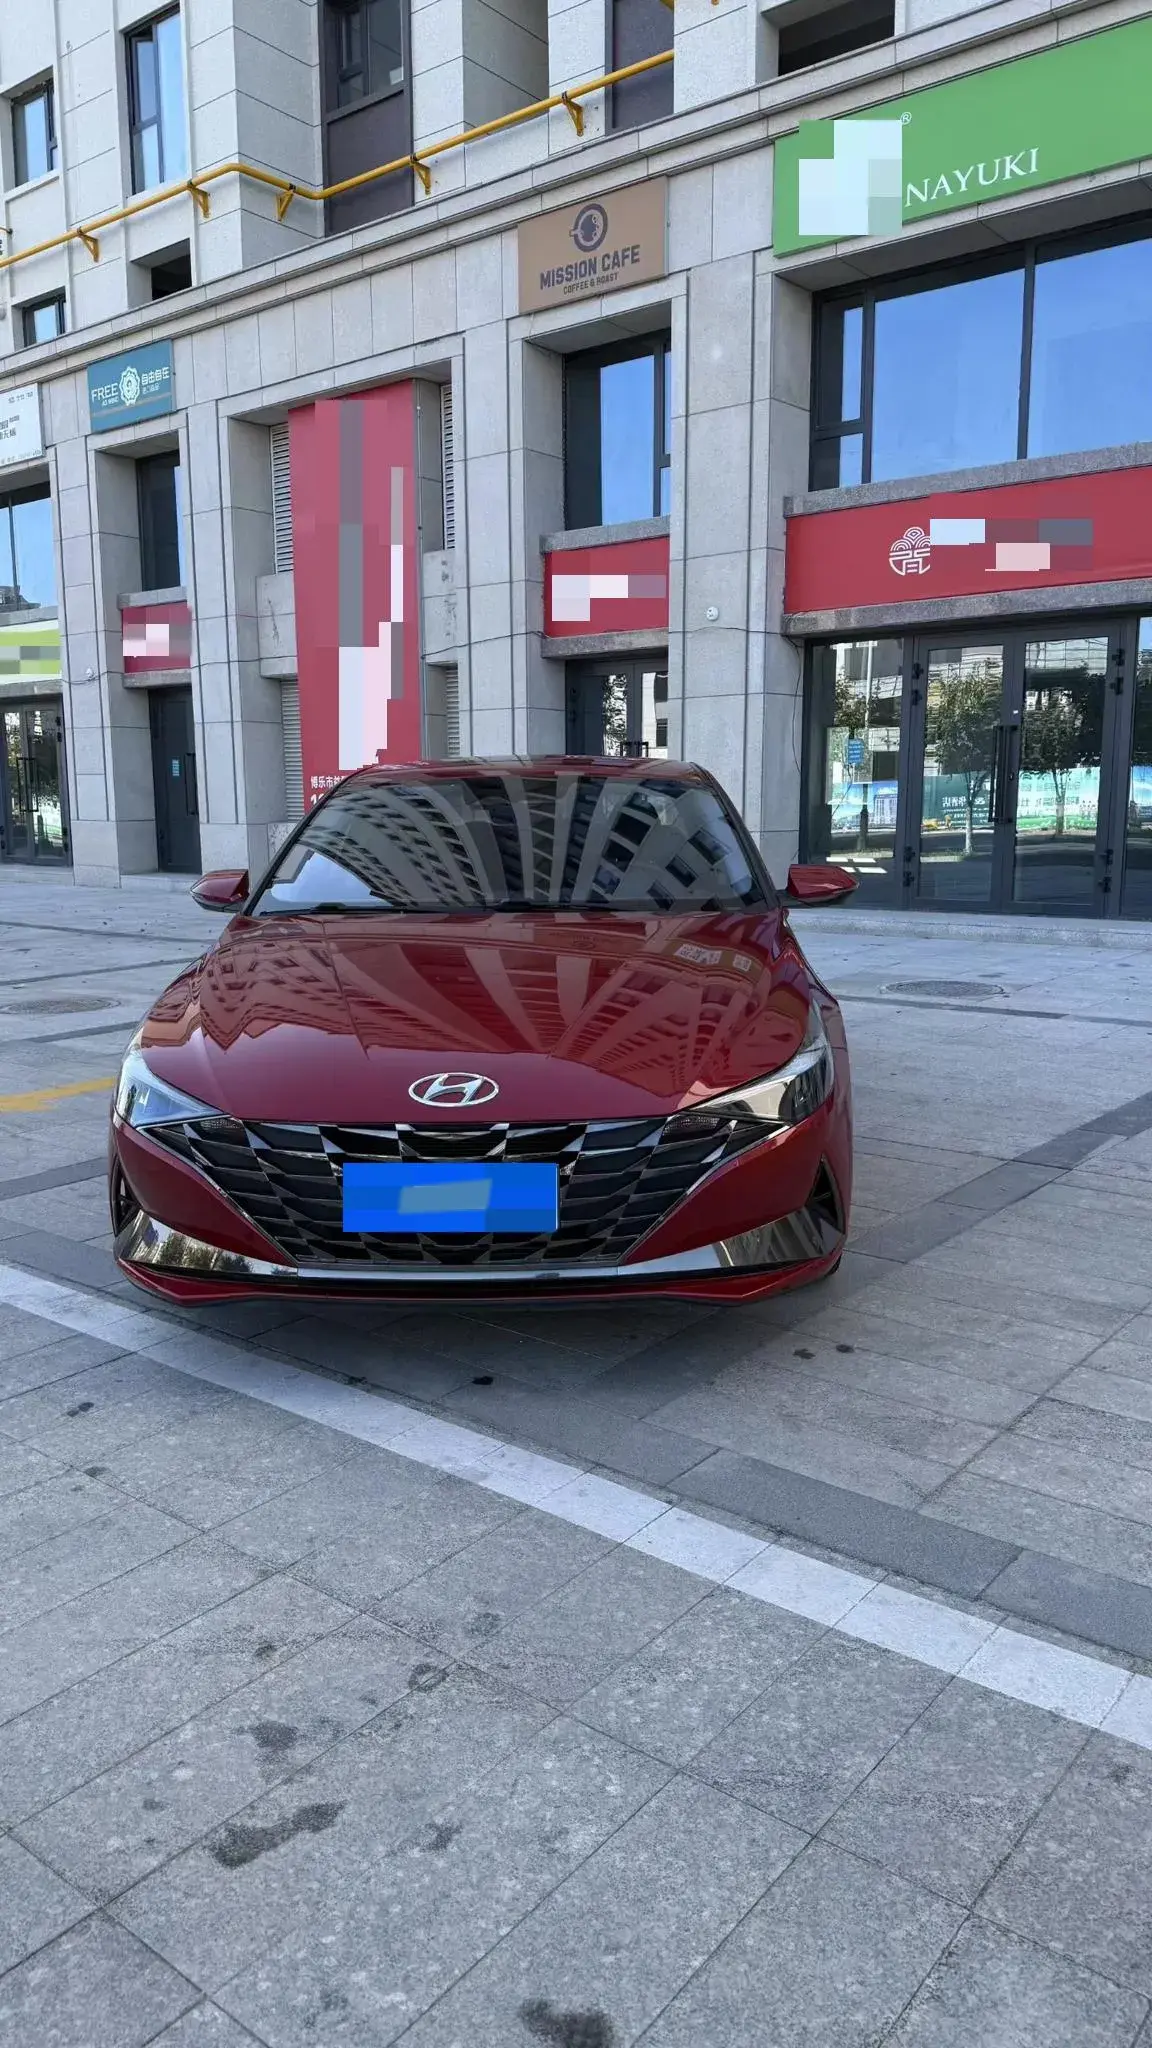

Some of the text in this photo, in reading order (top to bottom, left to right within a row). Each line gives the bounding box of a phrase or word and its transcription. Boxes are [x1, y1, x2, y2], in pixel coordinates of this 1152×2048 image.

[904, 147, 1039, 207] NAYUKI
[540, 245, 640, 290] MISSION CAFE
[563, 280, 588, 295] COFFEE
[596, 272, 620, 286] ROAST
[141, 366, 170, 386] 自由自在
[91, 383, 119, 403] FREE
[310, 775, 346, 789] 博乐市
